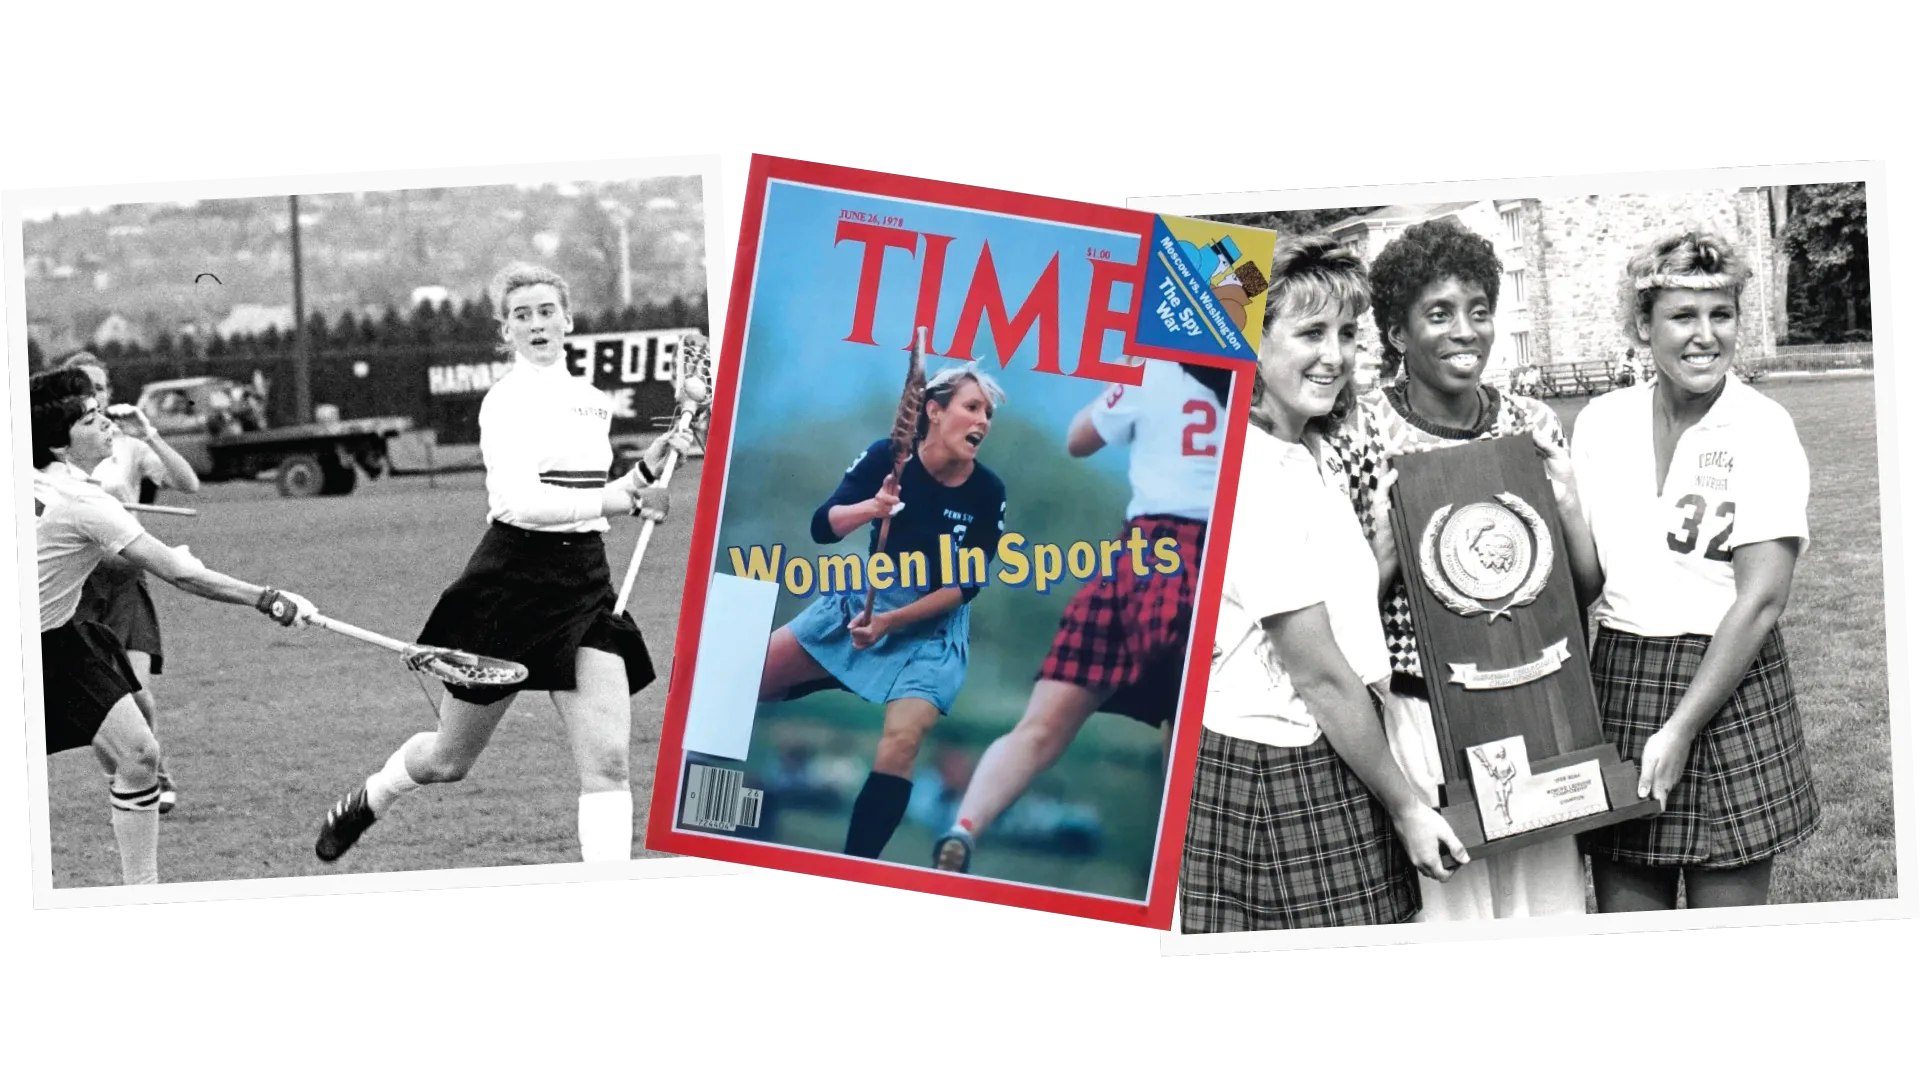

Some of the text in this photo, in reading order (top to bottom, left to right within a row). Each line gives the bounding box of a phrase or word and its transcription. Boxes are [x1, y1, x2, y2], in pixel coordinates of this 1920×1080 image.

[839, 209, 904, 227] JUNE 26, 1978
[834, 220, 1147, 387] TIME
[1156, 300, 1181, 333] War
[1158, 276, 1203, 337] The Spy
[1160, 236, 1242, 351] Moscow vs. Washington
[1181, 398, 1217, 457] 2
[1666, 493, 1736, 563] 32
[728, 544, 931, 597] Women
[938, 533, 991, 589] In
[998, 527, 1184, 593] Sports
